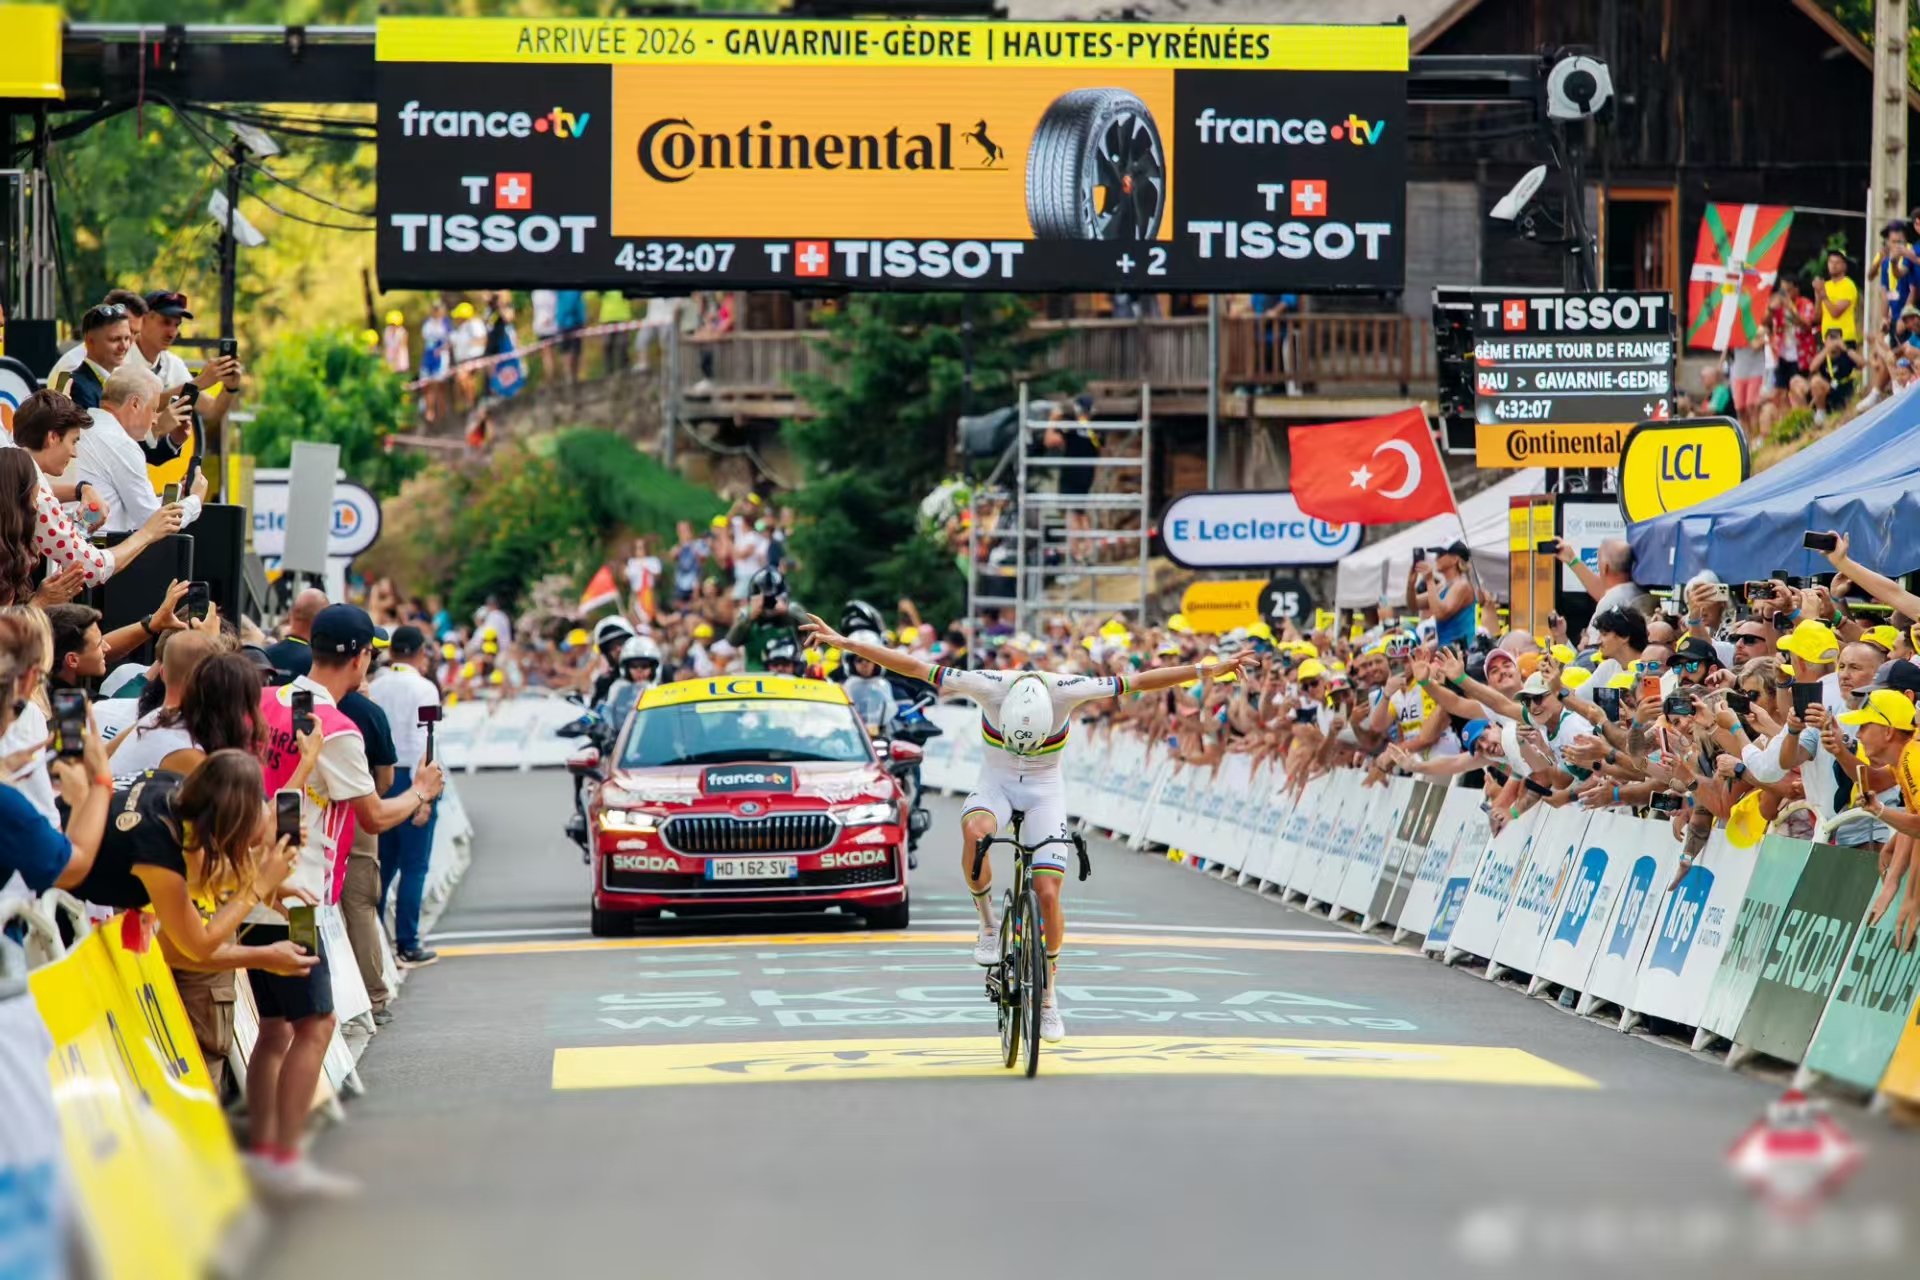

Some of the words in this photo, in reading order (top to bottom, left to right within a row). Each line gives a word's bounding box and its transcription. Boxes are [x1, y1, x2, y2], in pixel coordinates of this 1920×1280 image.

[517, 22, 627, 54] ARRIVÉE
[636, 27, 696, 54] 2026
[724, 25, 972, 57] GAVARNIE-GÈDRE
[1003, 27, 1271, 60] HAUTES-PYRÉNÉES
[637, 117, 953, 183] Continental
[391, 213, 597, 253] TISSOT
[1187, 220, 1392, 260] TISSOT
[614, 242, 736, 273] 4:32:07
[834, 240, 1025, 279] TISSOT
[1147, 247, 1168, 276] 2
[1530, 296, 1664, 330] TISSOT
[1513, 342, 1554, 360] ETAPE
[1555, 342, 1594, 360] TOUR
[1596, 342, 1615, 358] DE
[1616, 341, 1671, 358] FRANCE
[1478, 371, 1509, 390] PAU
[1534, 369, 1669, 390] GAVARNIE-GEDRE
[1494, 399, 1552, 419] 4:32:07
[1658, 398, 1669, 418] 2
[1506, 429, 1623, 461] Continental
[1661, 443, 1710, 482] LCL
[1270, 591, 1300, 618] 25
[709, 680, 776, 695] LCL
[1014, 729, 1033, 740] G42
[613, 855, 680, 872] SKODA
[820, 849, 887, 868] SKODA
[1762, 908, 1853, 997] SKODA
